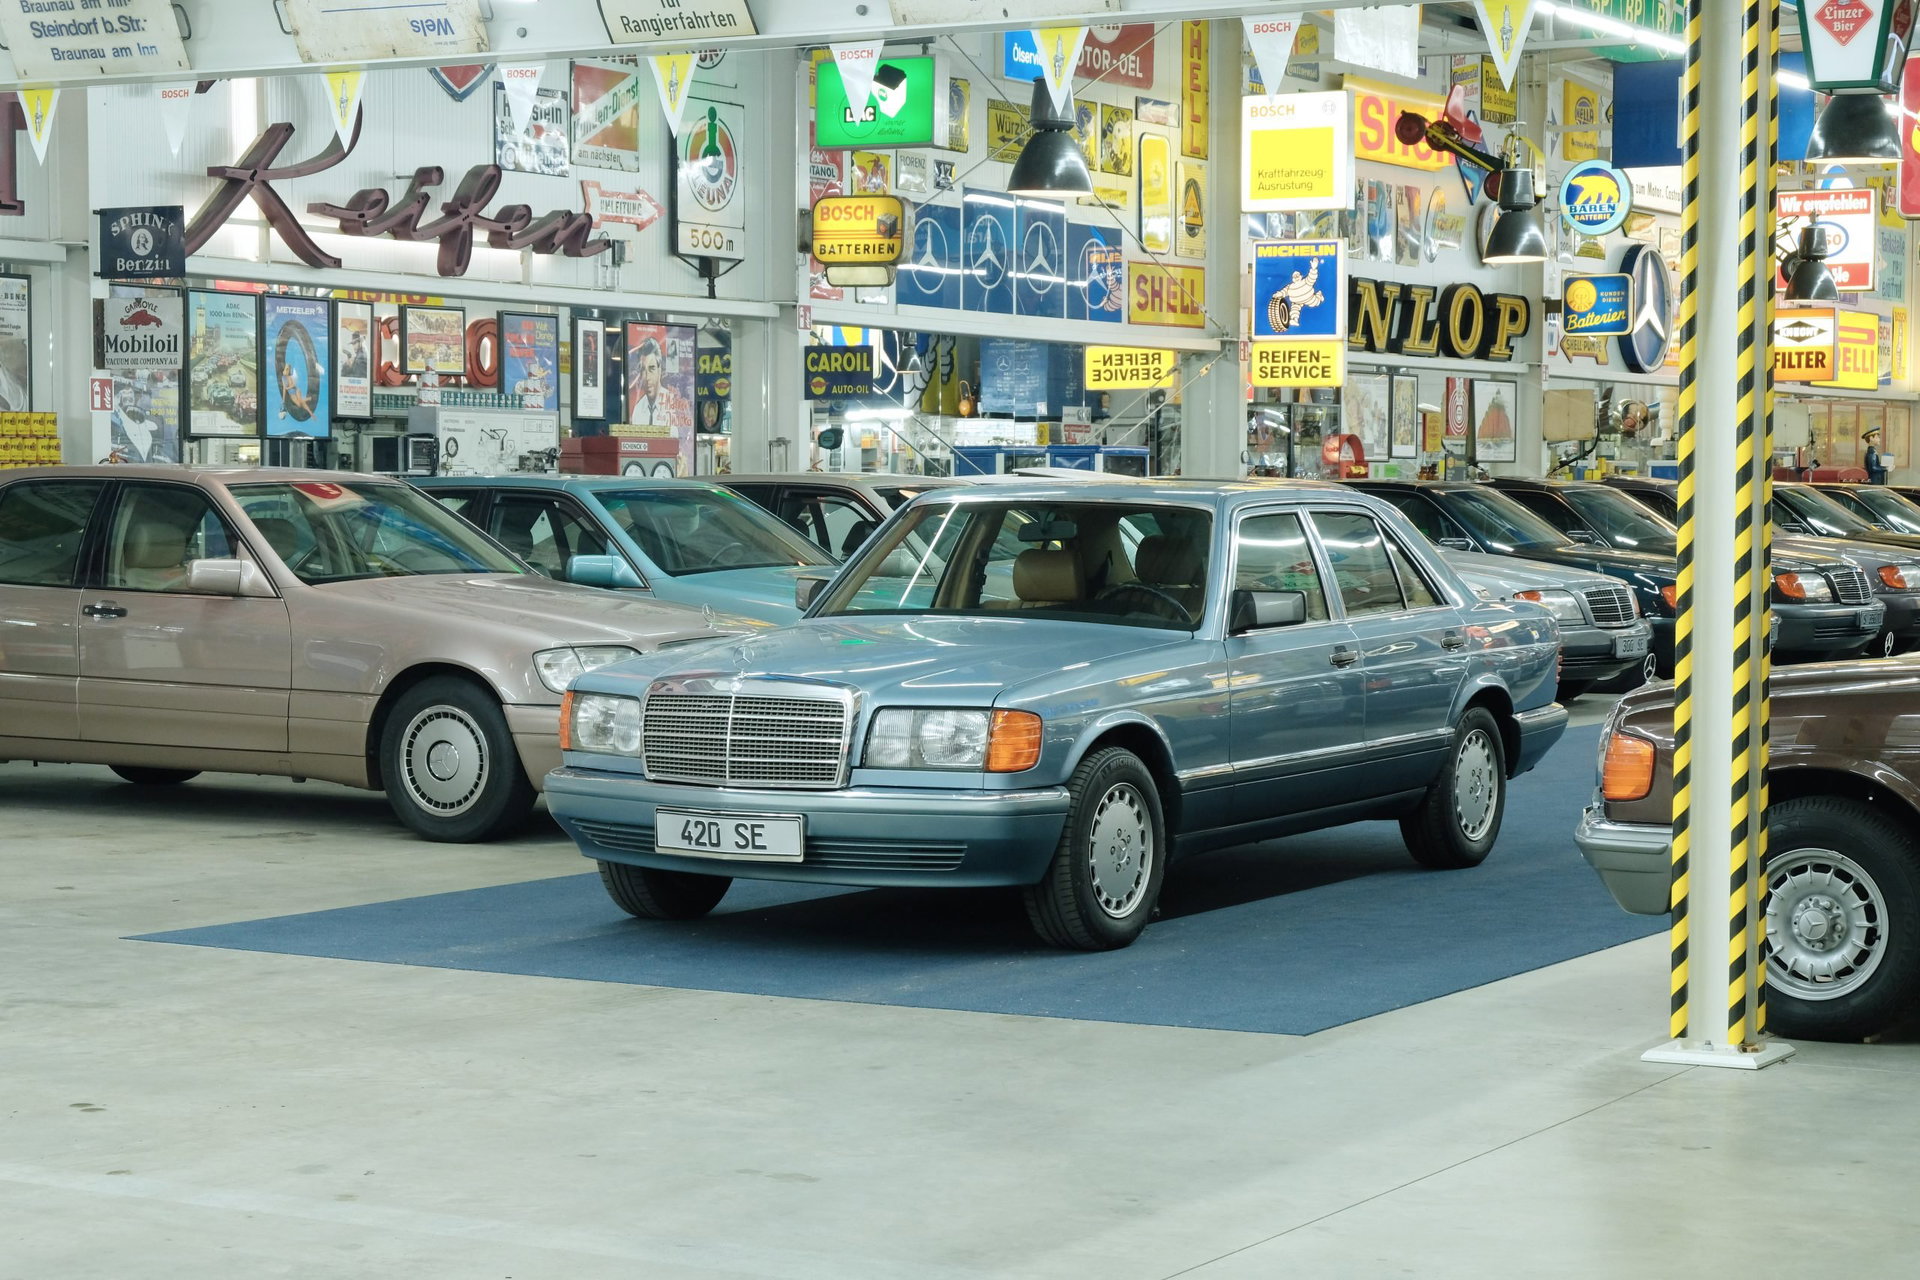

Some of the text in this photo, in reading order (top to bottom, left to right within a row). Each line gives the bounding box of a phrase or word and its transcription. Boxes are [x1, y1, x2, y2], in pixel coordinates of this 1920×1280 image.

[1824, 6, 1865, 20] Linzer
[30, 18, 99, 39] Steindorf
[410, 18, 455, 37] Wels
[620, 11, 737, 36] Rangierfahrten
[1253, 22, 1292, 34] BOSCH
[1833, 21, 1856, 32] Bier
[50, 42, 159, 61] Braunau am Inn
[840, 49, 874, 61] BOSCH
[507, 69, 537, 79] BOSCH
[161, 89, 190, 99] BOSCH
[1250, 104, 1295, 118] BOSCH
[1803, 193, 1868, 215] empfehlen
[820, 206, 874, 222] BOSCH
[690, 228, 734, 252] 500 m
[819, 243, 895, 255] BATTERIEN
[1257, 244, 1336, 257] MICHELIN
[116, 254, 171, 272] Benzin
[1135, 273, 1200, 316] SHELL
[276, 305, 316, 316] METZELER
[1347, 279, 1529, 359] NLOP
[1565, 308, 1627, 331] Batterien
[105, 334, 178, 353] Mobiloil
[806, 352, 871, 372] CAROIL
[1774, 351, 1827, 369] FILTER
[1259, 365, 1332, 379] SERVICE
[681, 819, 767, 850] 420 SE
